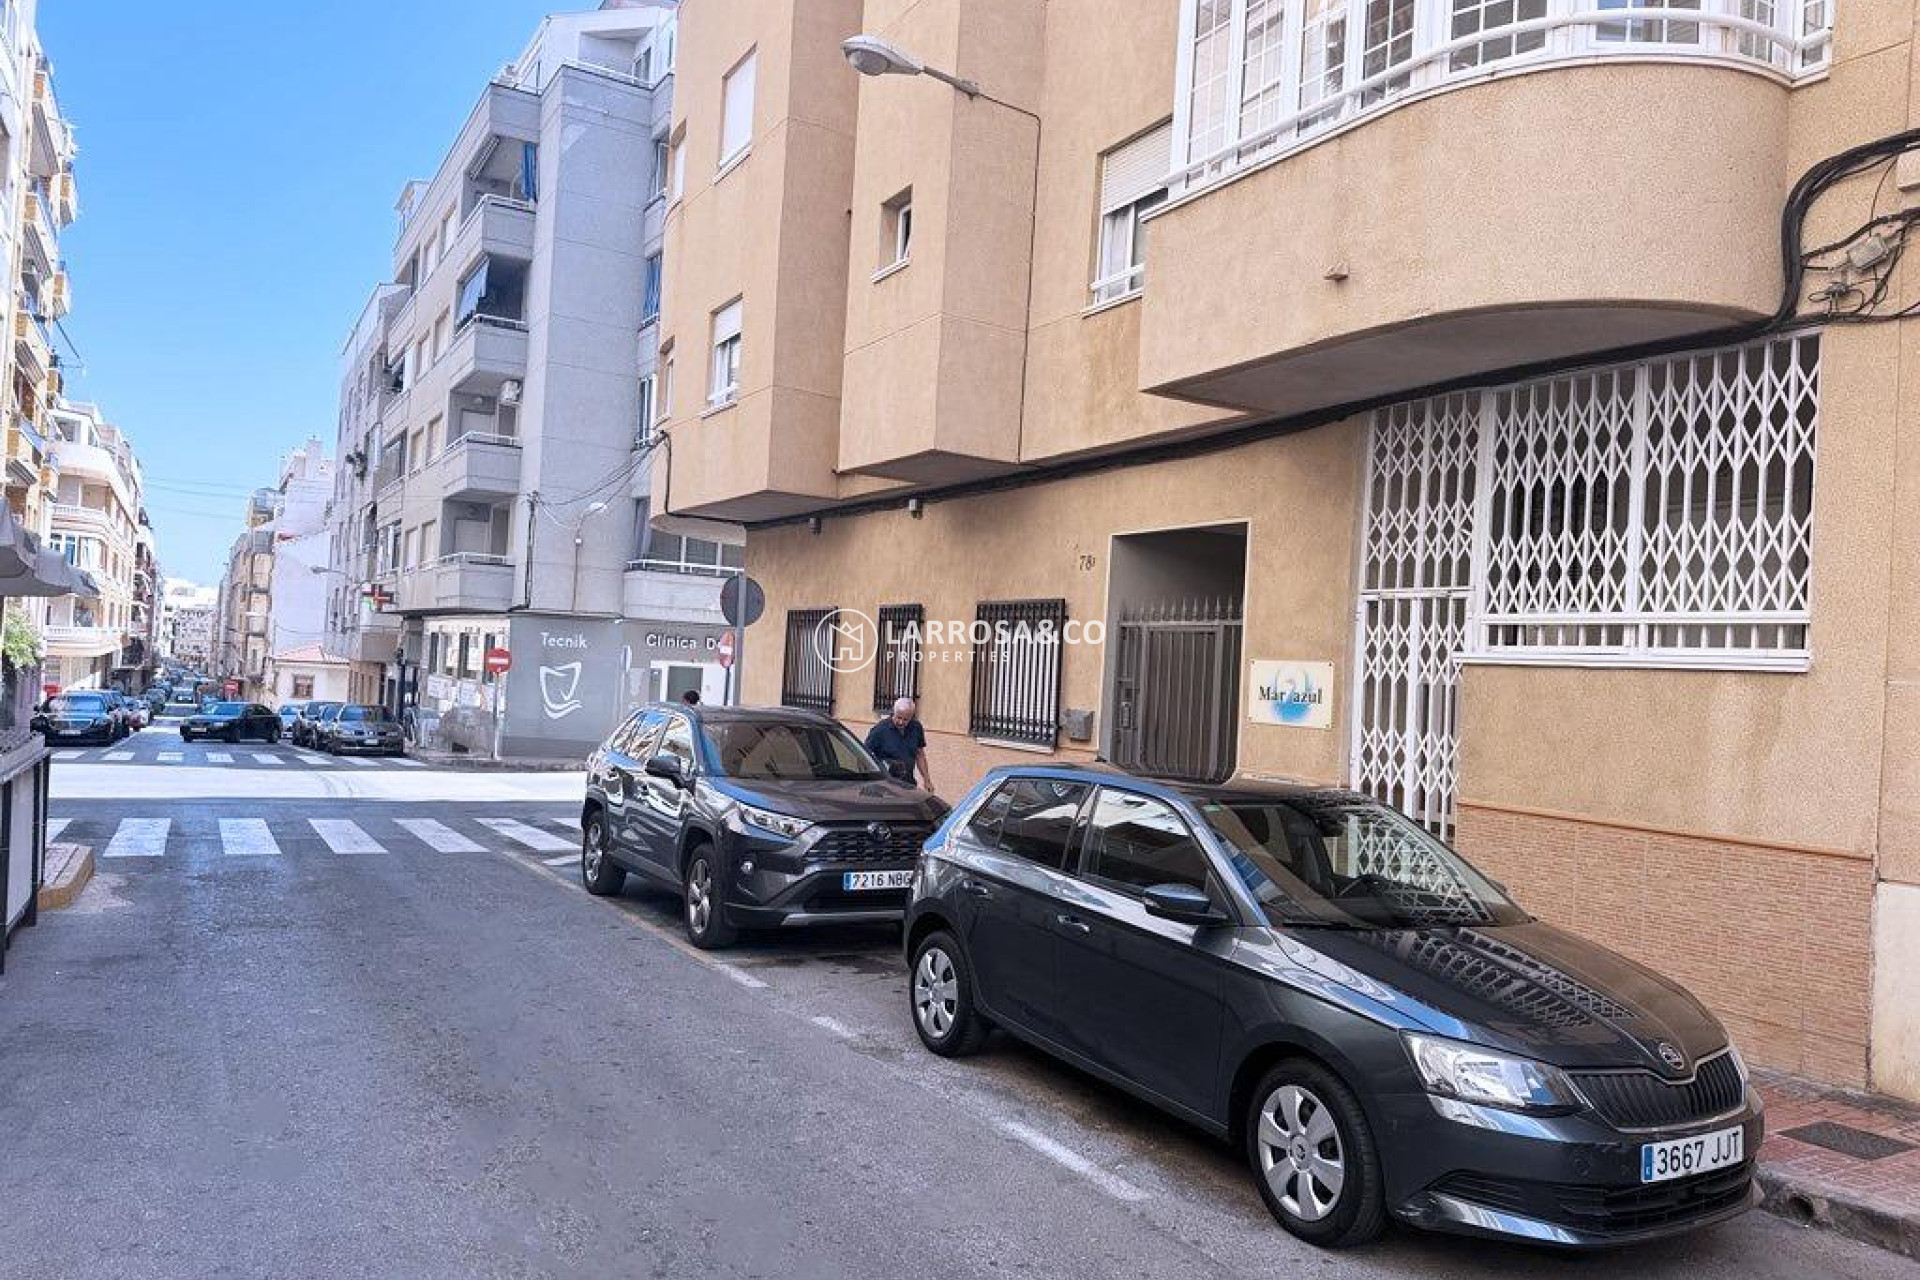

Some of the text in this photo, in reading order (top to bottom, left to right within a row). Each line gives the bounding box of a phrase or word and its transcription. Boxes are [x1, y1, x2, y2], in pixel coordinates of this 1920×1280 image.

[540, 632, 587, 649] Tecnik
[1259, 685, 1322, 704] Mar azul
[853, 873, 884, 887] 7216
[1657, 1131, 1739, 1174] 3667 JJT
